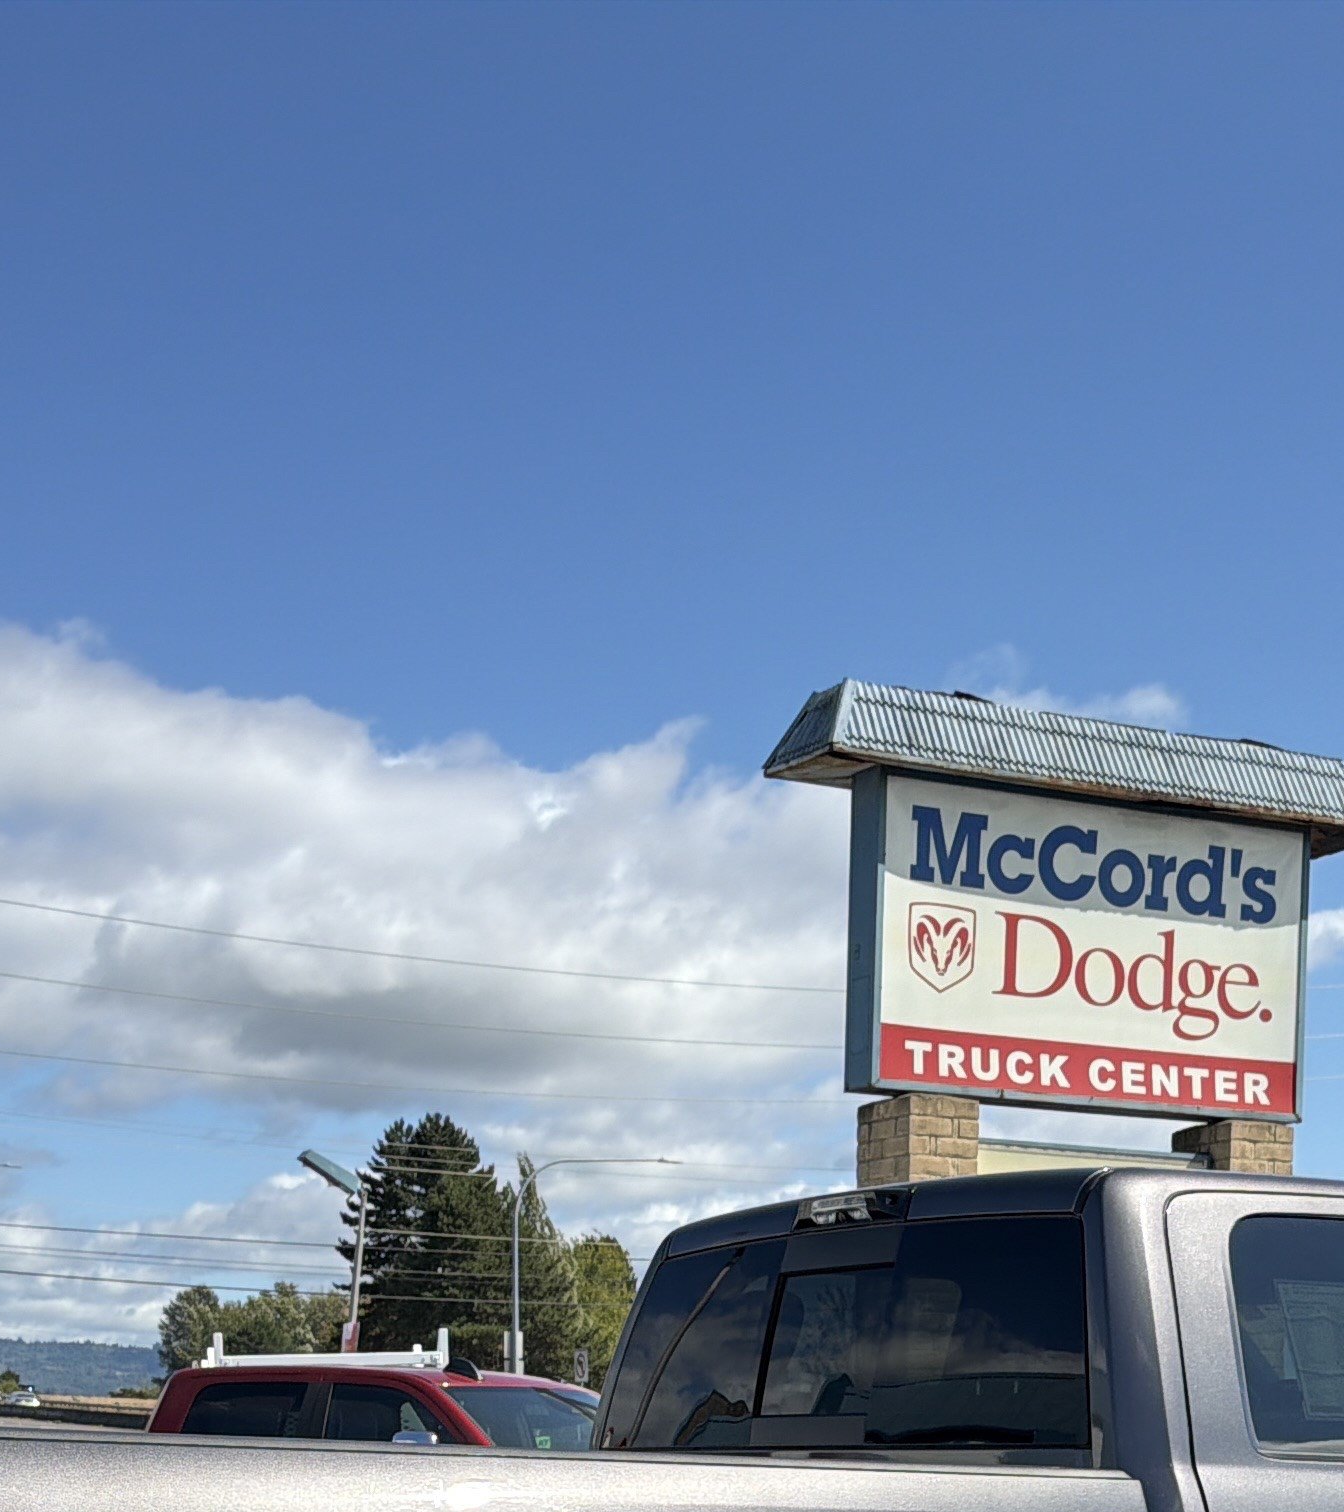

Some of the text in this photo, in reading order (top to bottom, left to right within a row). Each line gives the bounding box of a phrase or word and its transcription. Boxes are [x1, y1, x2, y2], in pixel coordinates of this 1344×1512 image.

[910, 804, 1277, 924] McCord's
[904, 1040, 1270, 1105] TRUCK CENTER
